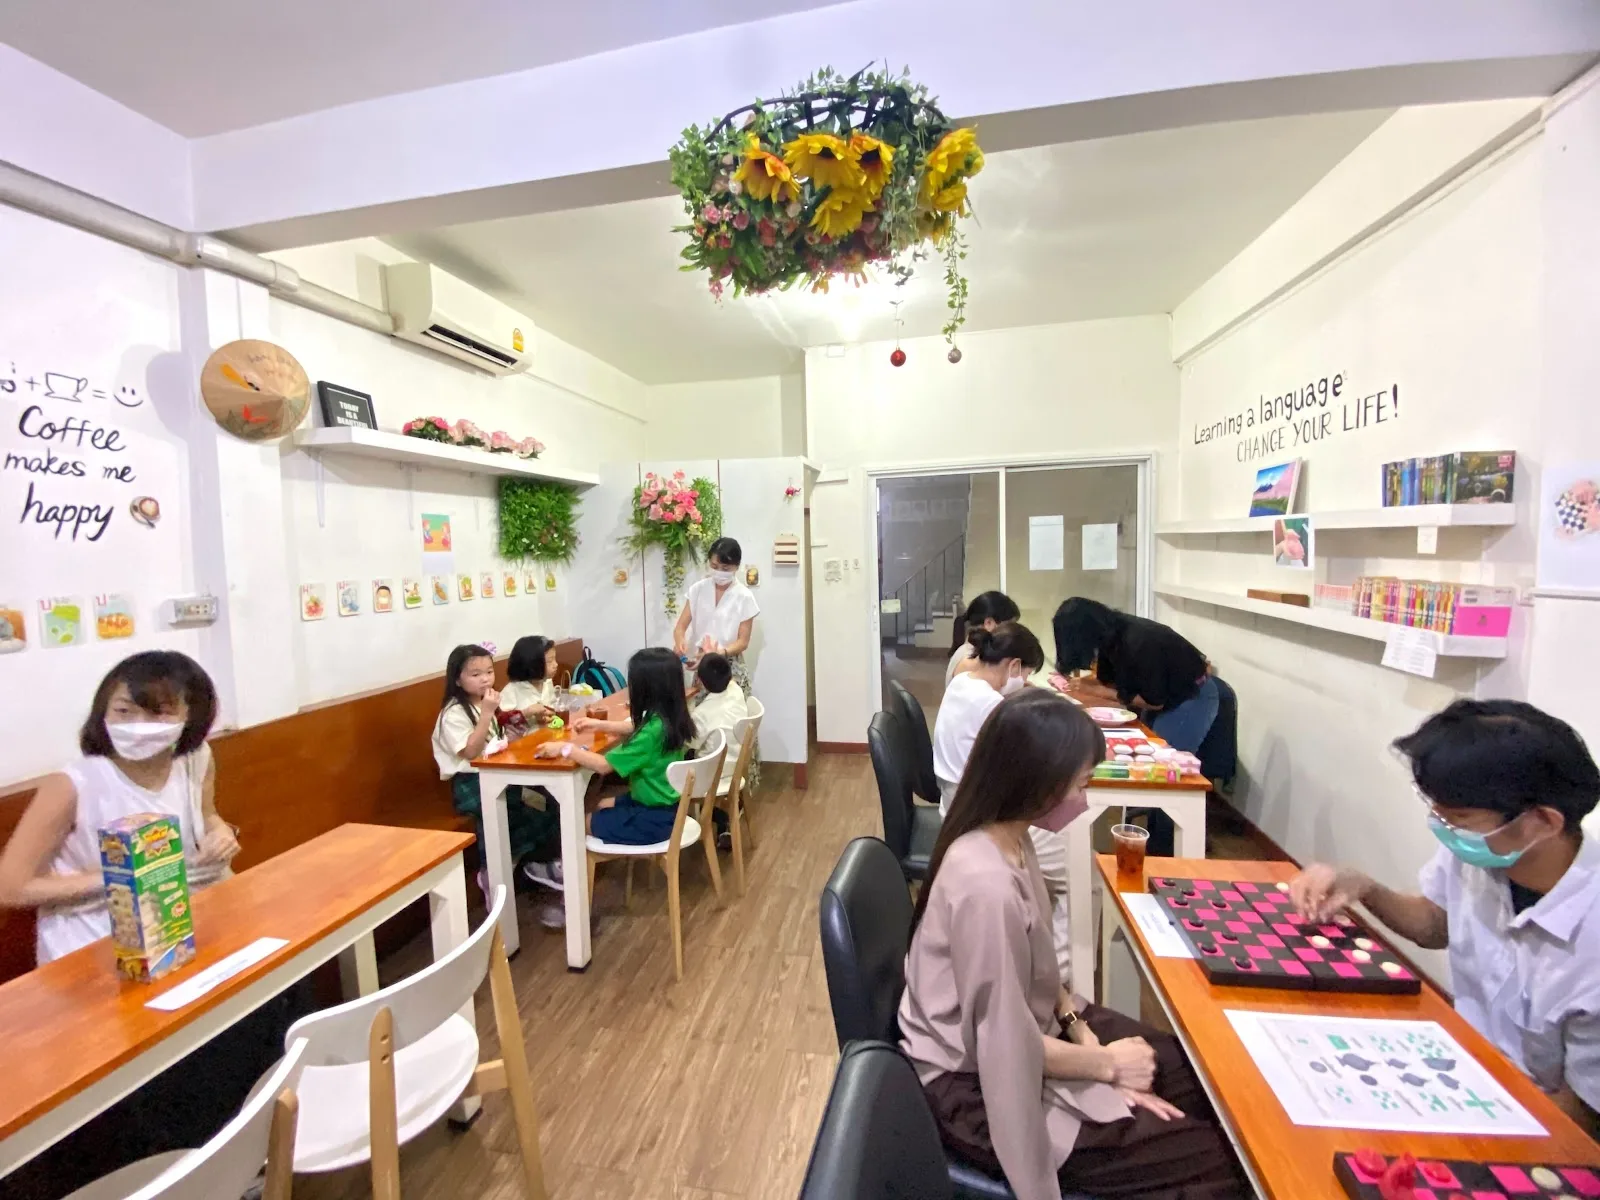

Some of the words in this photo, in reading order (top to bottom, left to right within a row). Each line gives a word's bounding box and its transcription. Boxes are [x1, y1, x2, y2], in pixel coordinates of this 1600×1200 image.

[18, 405, 127, 451] Coffee
[1193, 412, 1243, 445] Learning
[1247, 408, 1255, 427] a
[1260, 373, 1344, 425] language
[1236, 426, 1286, 463] CHANGE
[1292, 411, 1332, 447] YOUR
[1343, 383, 1399, 432] LIFE!
[4, 448, 87, 477] makes
[103, 464, 137, 483] me
[20, 482, 114, 542] happy
